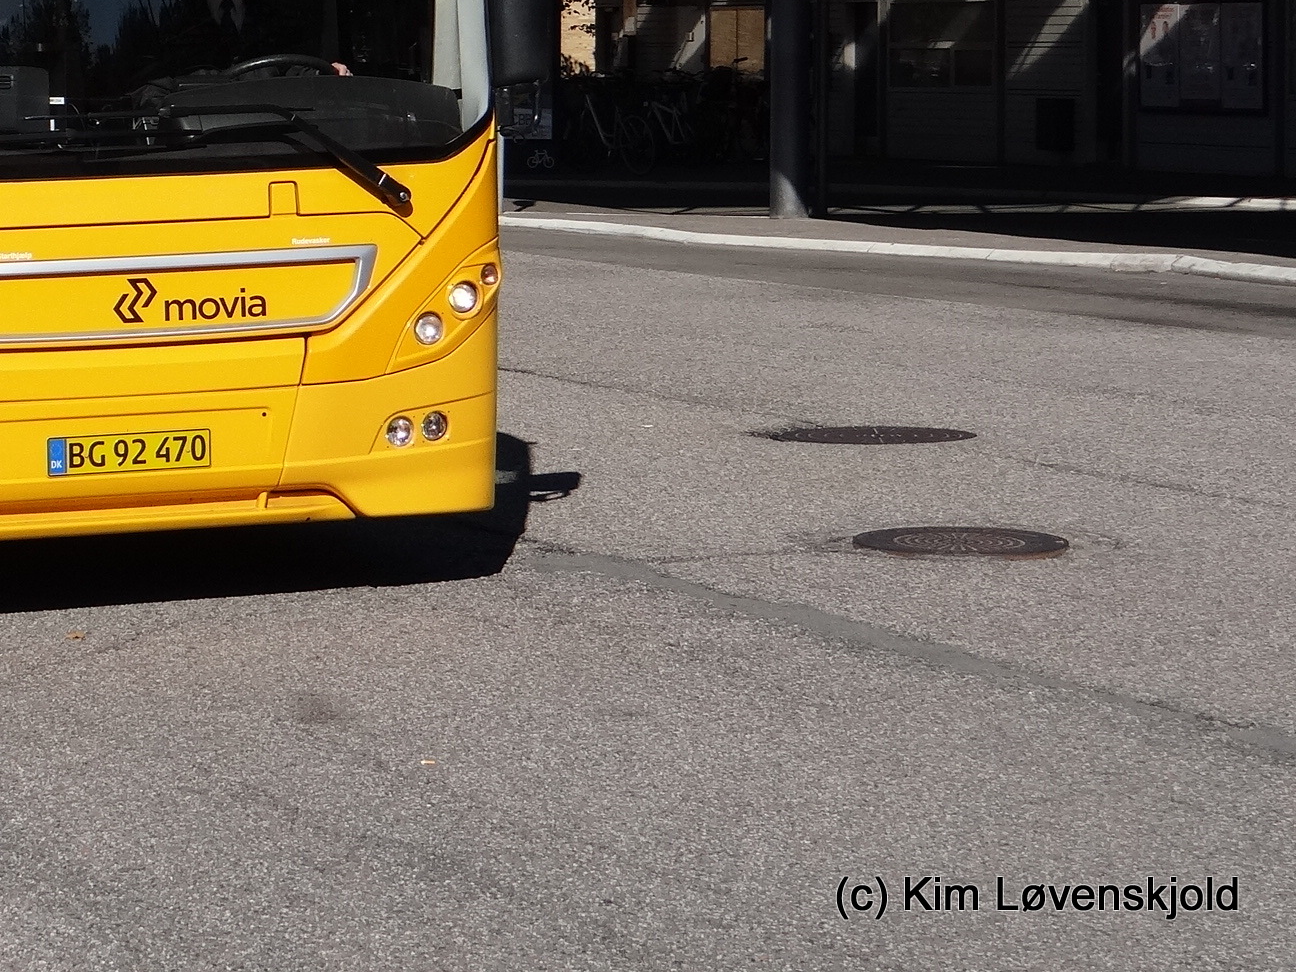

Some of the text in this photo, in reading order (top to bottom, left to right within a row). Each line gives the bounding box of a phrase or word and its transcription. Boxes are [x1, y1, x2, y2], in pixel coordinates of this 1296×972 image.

[165, 288, 266, 321] movia
[50, 460, 62, 469] DK
[69, 435, 206, 468] BG 92 470
